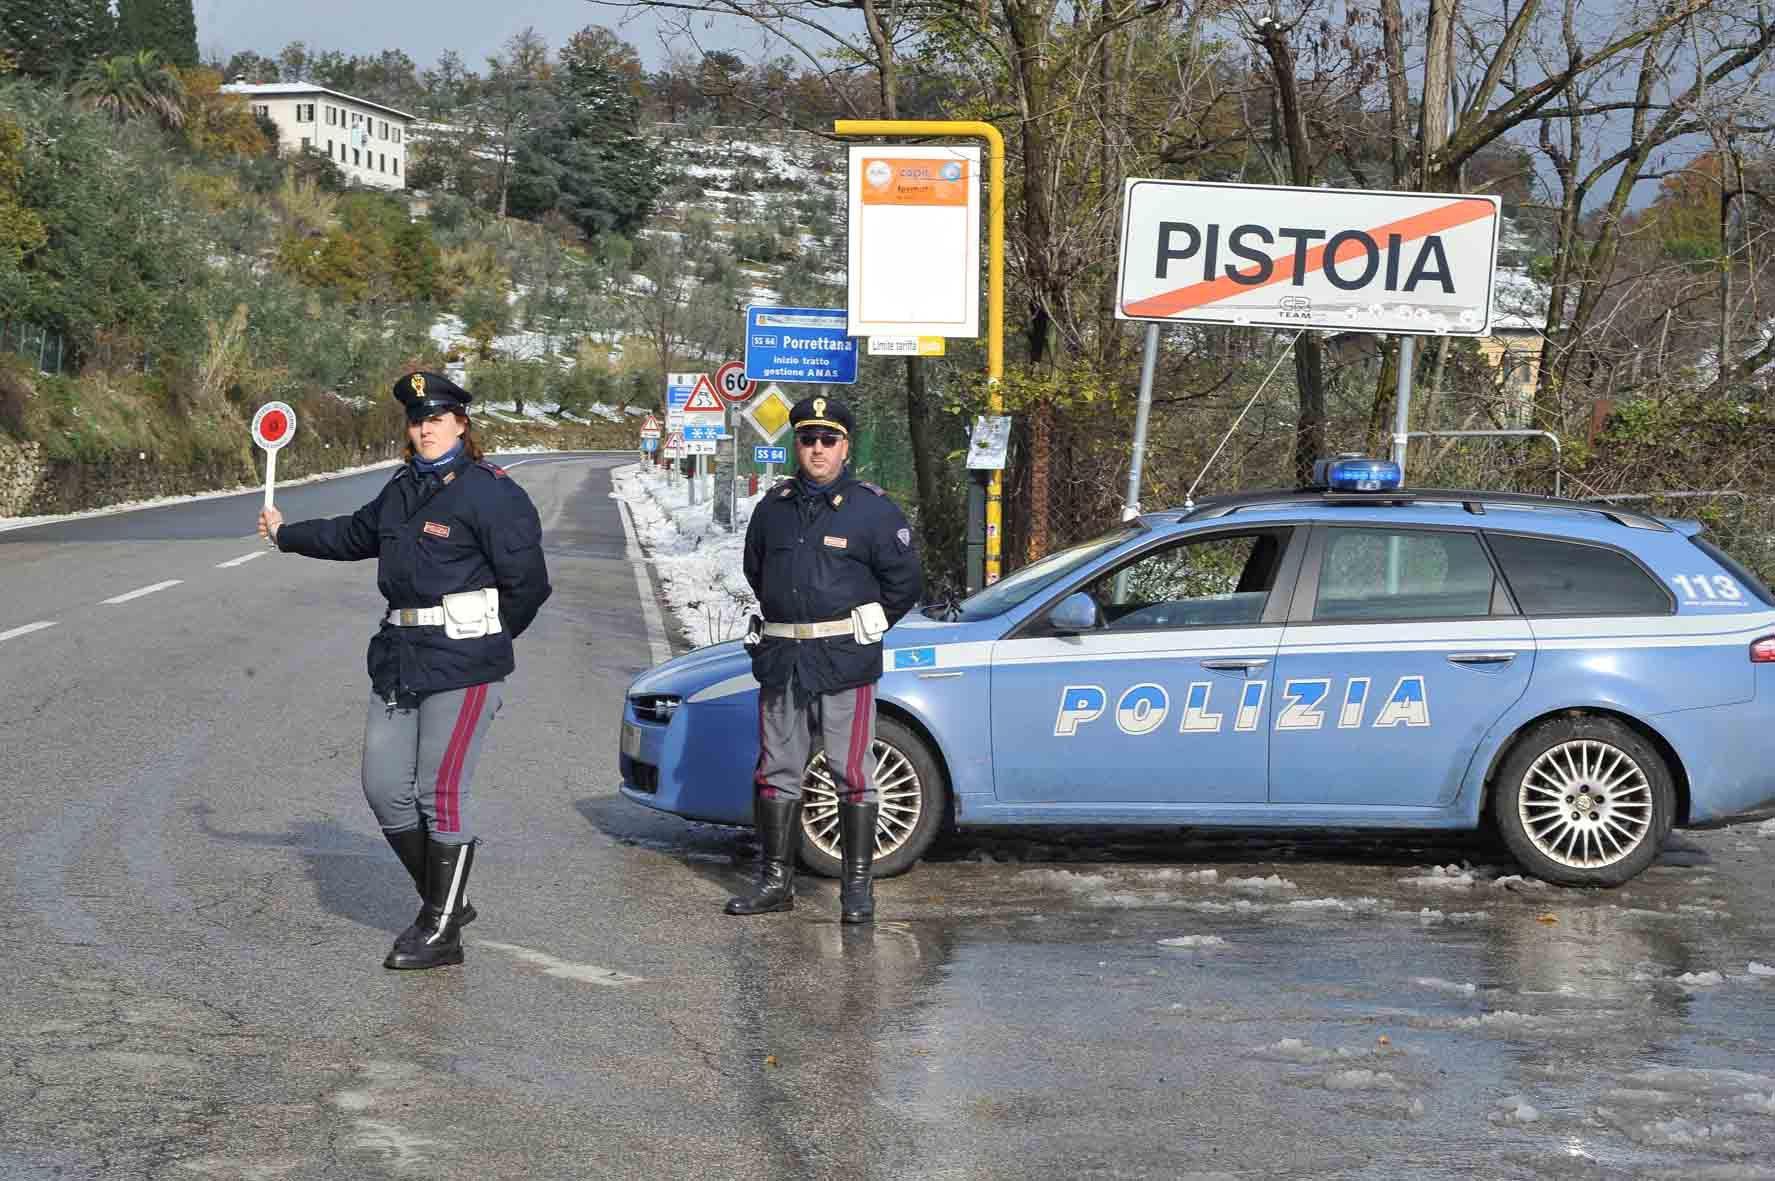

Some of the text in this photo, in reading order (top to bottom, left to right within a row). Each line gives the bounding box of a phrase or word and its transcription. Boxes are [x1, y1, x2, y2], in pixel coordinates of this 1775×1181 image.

[1155, 221, 1456, 294] PISTOIA
[783, 336, 852, 351] Porrettana
[773, 355, 830, 366] inizio tratto
[763, 368, 839, 377] gestione ANAS
[725, 373, 748, 391] 60
[757, 450, 784, 459] SS 64
[1671, 574, 1742, 600] 113
[1053, 676, 1431, 736] POLIZIA
